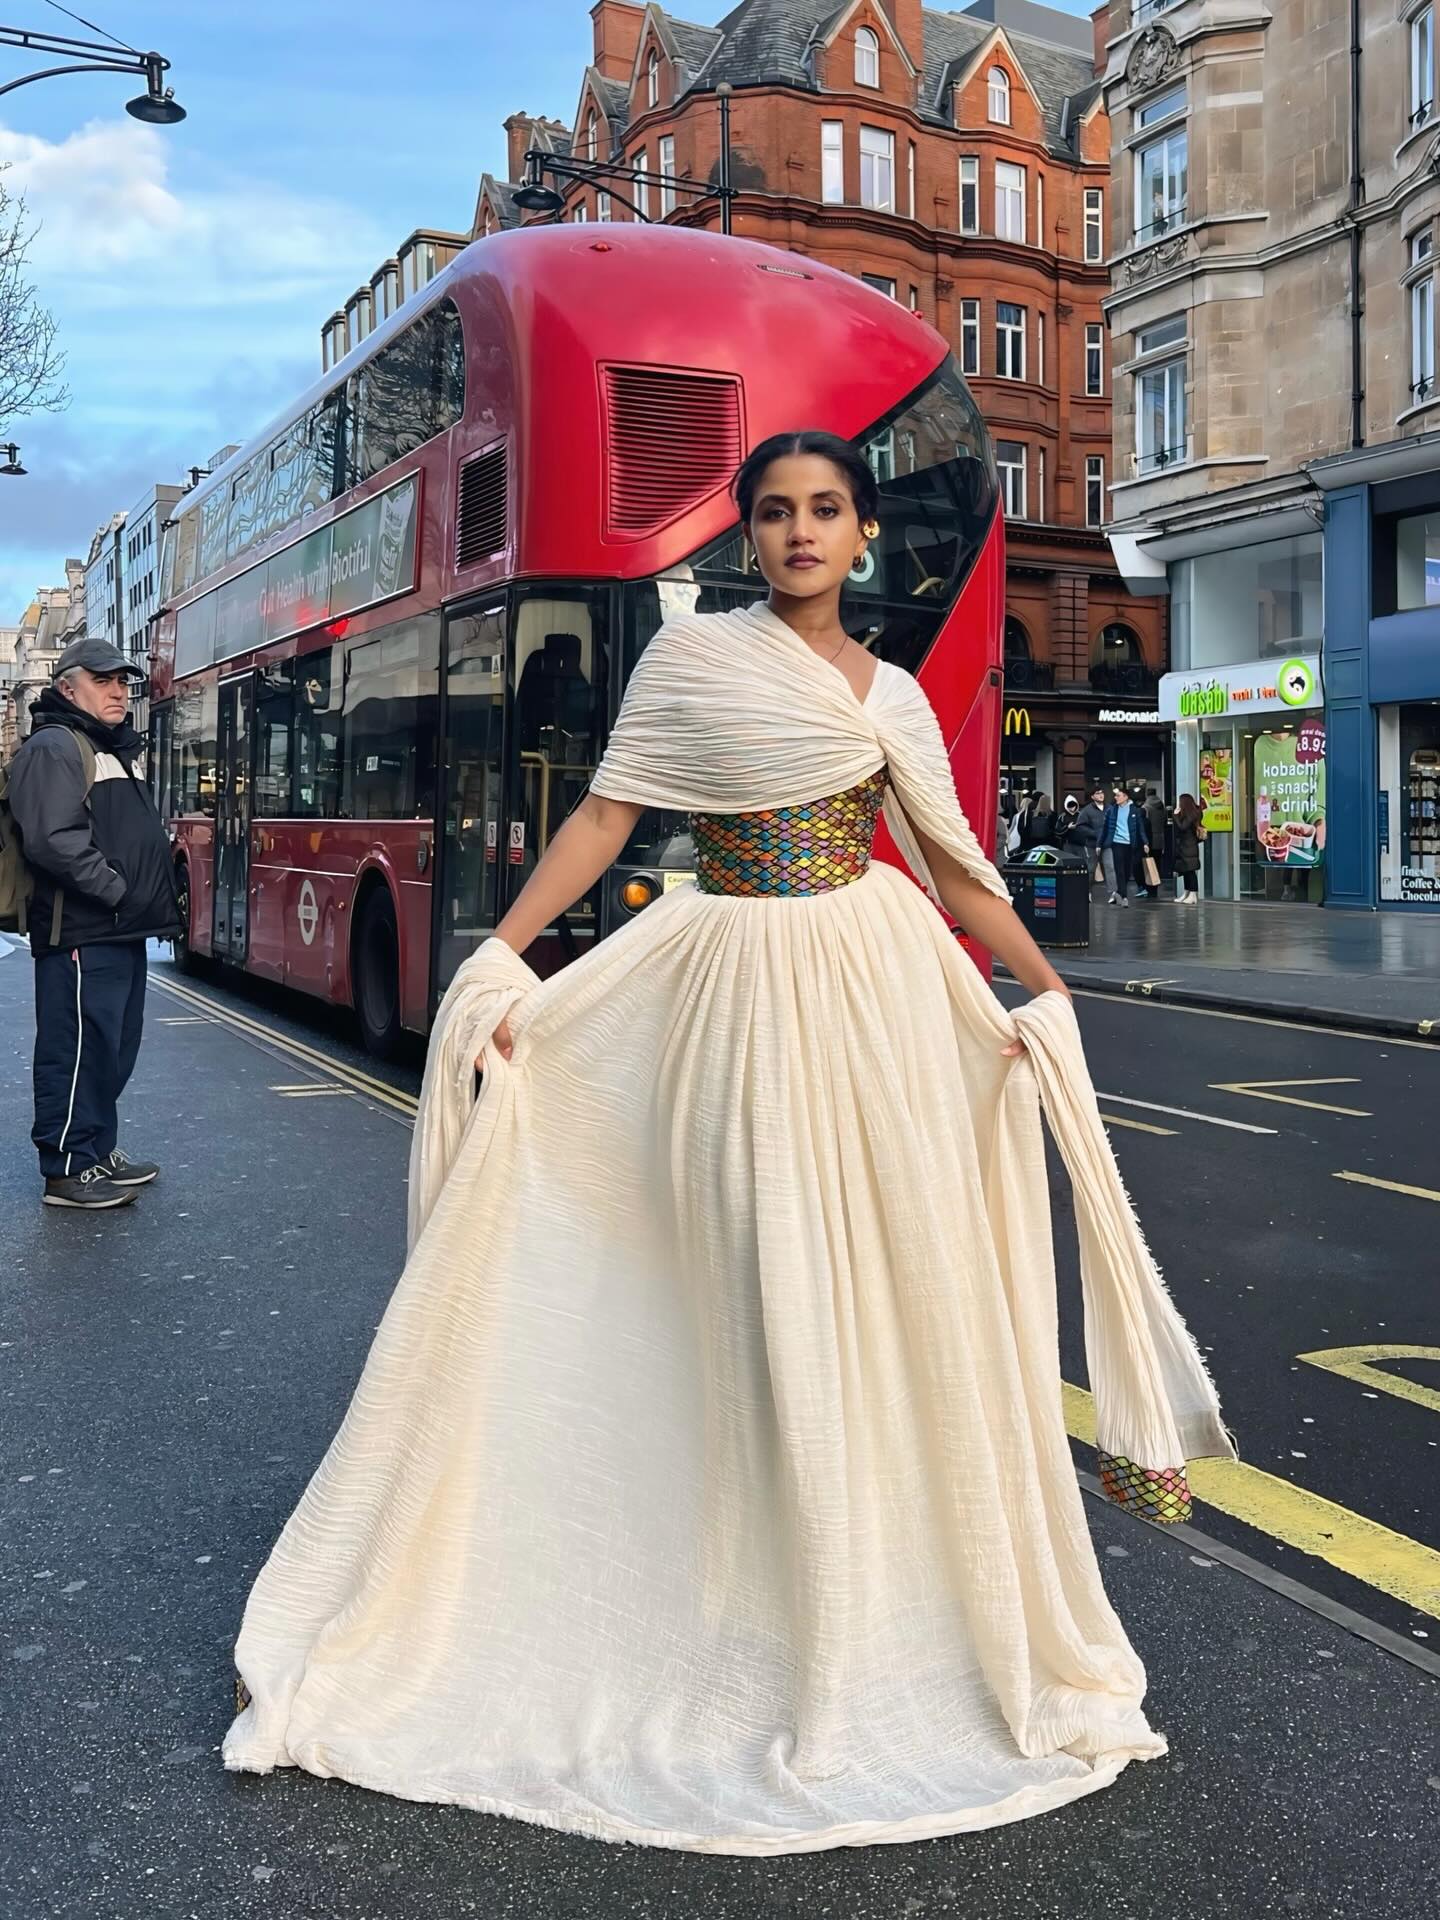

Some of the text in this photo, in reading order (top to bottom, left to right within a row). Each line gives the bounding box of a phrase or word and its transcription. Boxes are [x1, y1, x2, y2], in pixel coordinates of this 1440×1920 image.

[277, 573, 304, 609] Health
[307, 560, 328, 596] with
[332, 536, 371, 584] Biotiful
[1263, 760, 1318, 777] kobachi
[1277, 777, 1318, 794] snack
[1281, 798, 1318, 813] drink
[1402, 878, 1433, 889] Coffee
